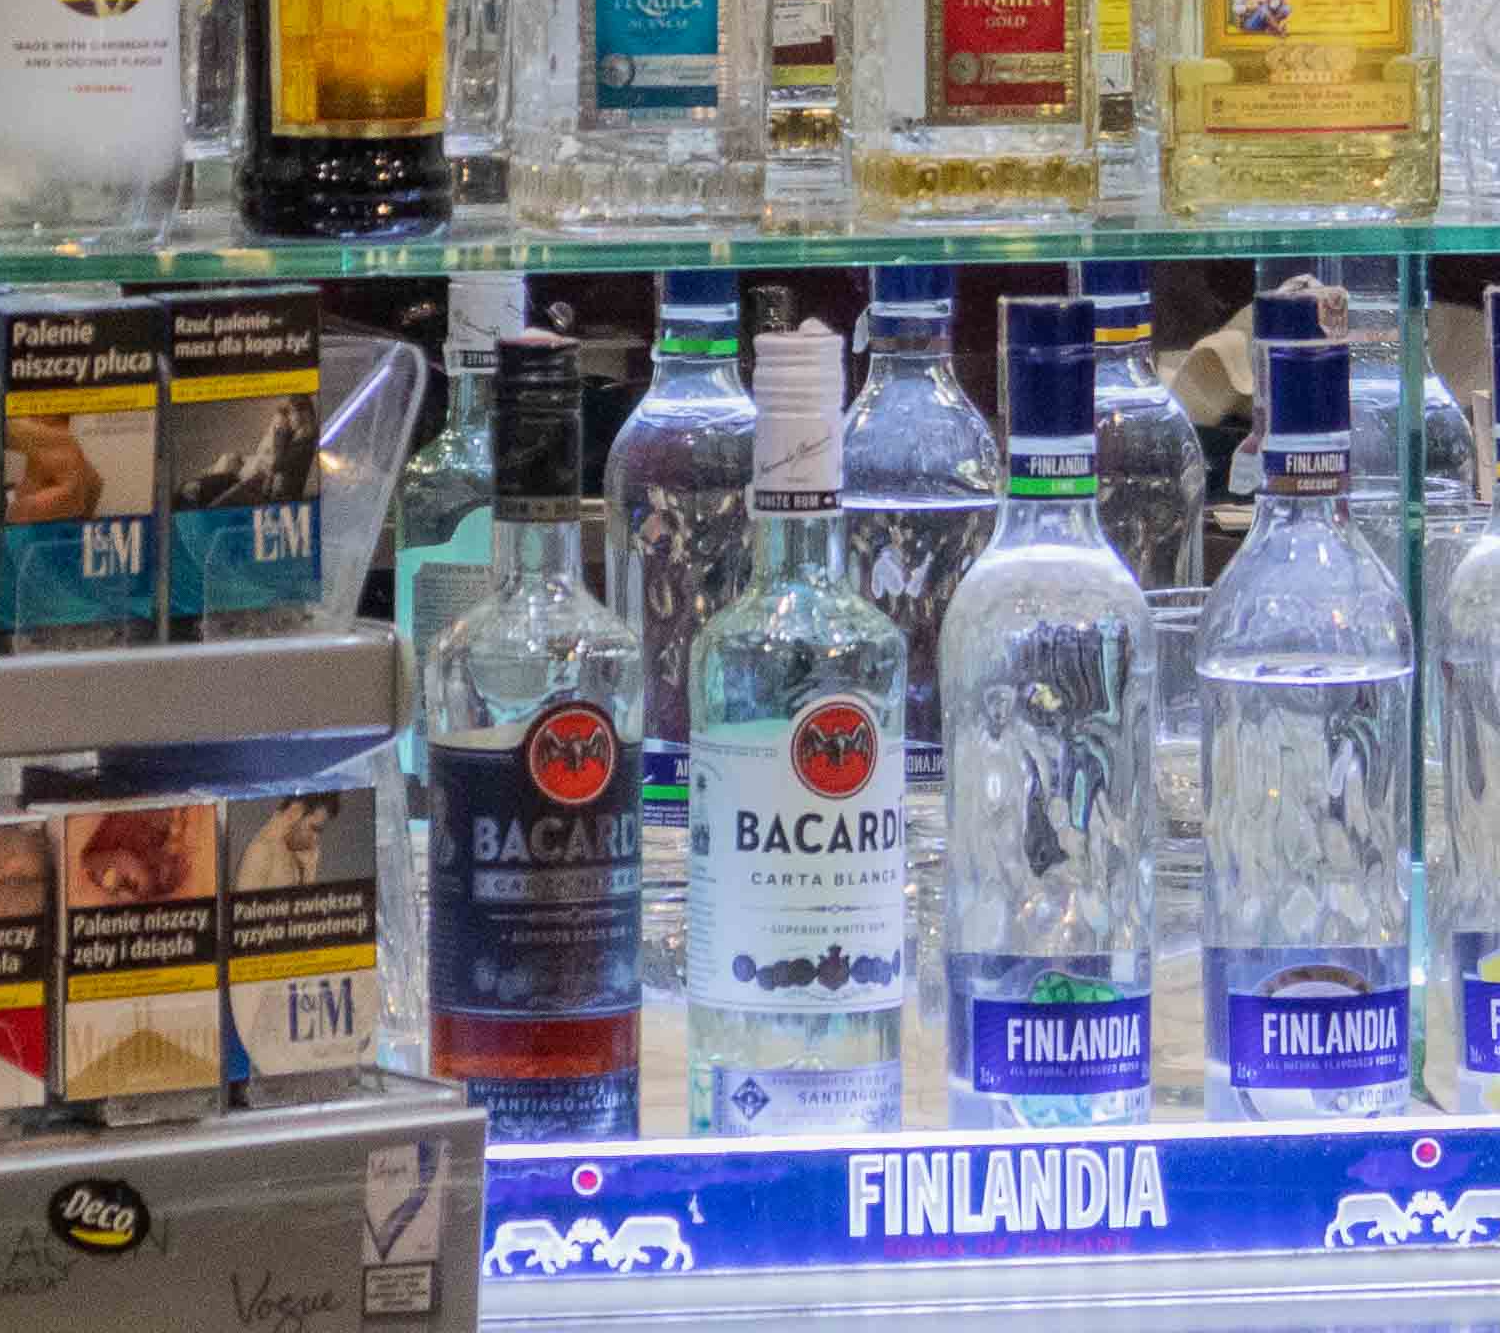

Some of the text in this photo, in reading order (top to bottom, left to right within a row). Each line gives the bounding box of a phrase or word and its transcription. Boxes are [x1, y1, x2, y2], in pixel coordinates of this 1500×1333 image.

[984, 14, 1028, 30] GOLD
[11, 319, 95, 348] Palenie
[174, 313, 270, 337] Rzuć palenie
[174, 332, 284, 358] masz dla kogo
[11, 350, 153, 382] niszczy płuca
[1028, 454, 1090, 476] FINLANDIA
[1285, 452, 1345, 474] FINLANDIA
[750, 871, 823, 887] CARTA
[232, 891, 365, 922] Palenie zwiększa
[72, 907, 210, 939] Palenie niszczy
[232, 910, 370, 947] ryzyko impotencji
[72, 934, 195, 967] zęby i dziąsła
[1006, 1013, 1142, 1064] FINLANDIA
[1261, 1007, 1399, 1056] FINLANDIA
[847, 1143, 1168, 1240] FINLANDIA
[62, 1188, 135, 1230] Deco
